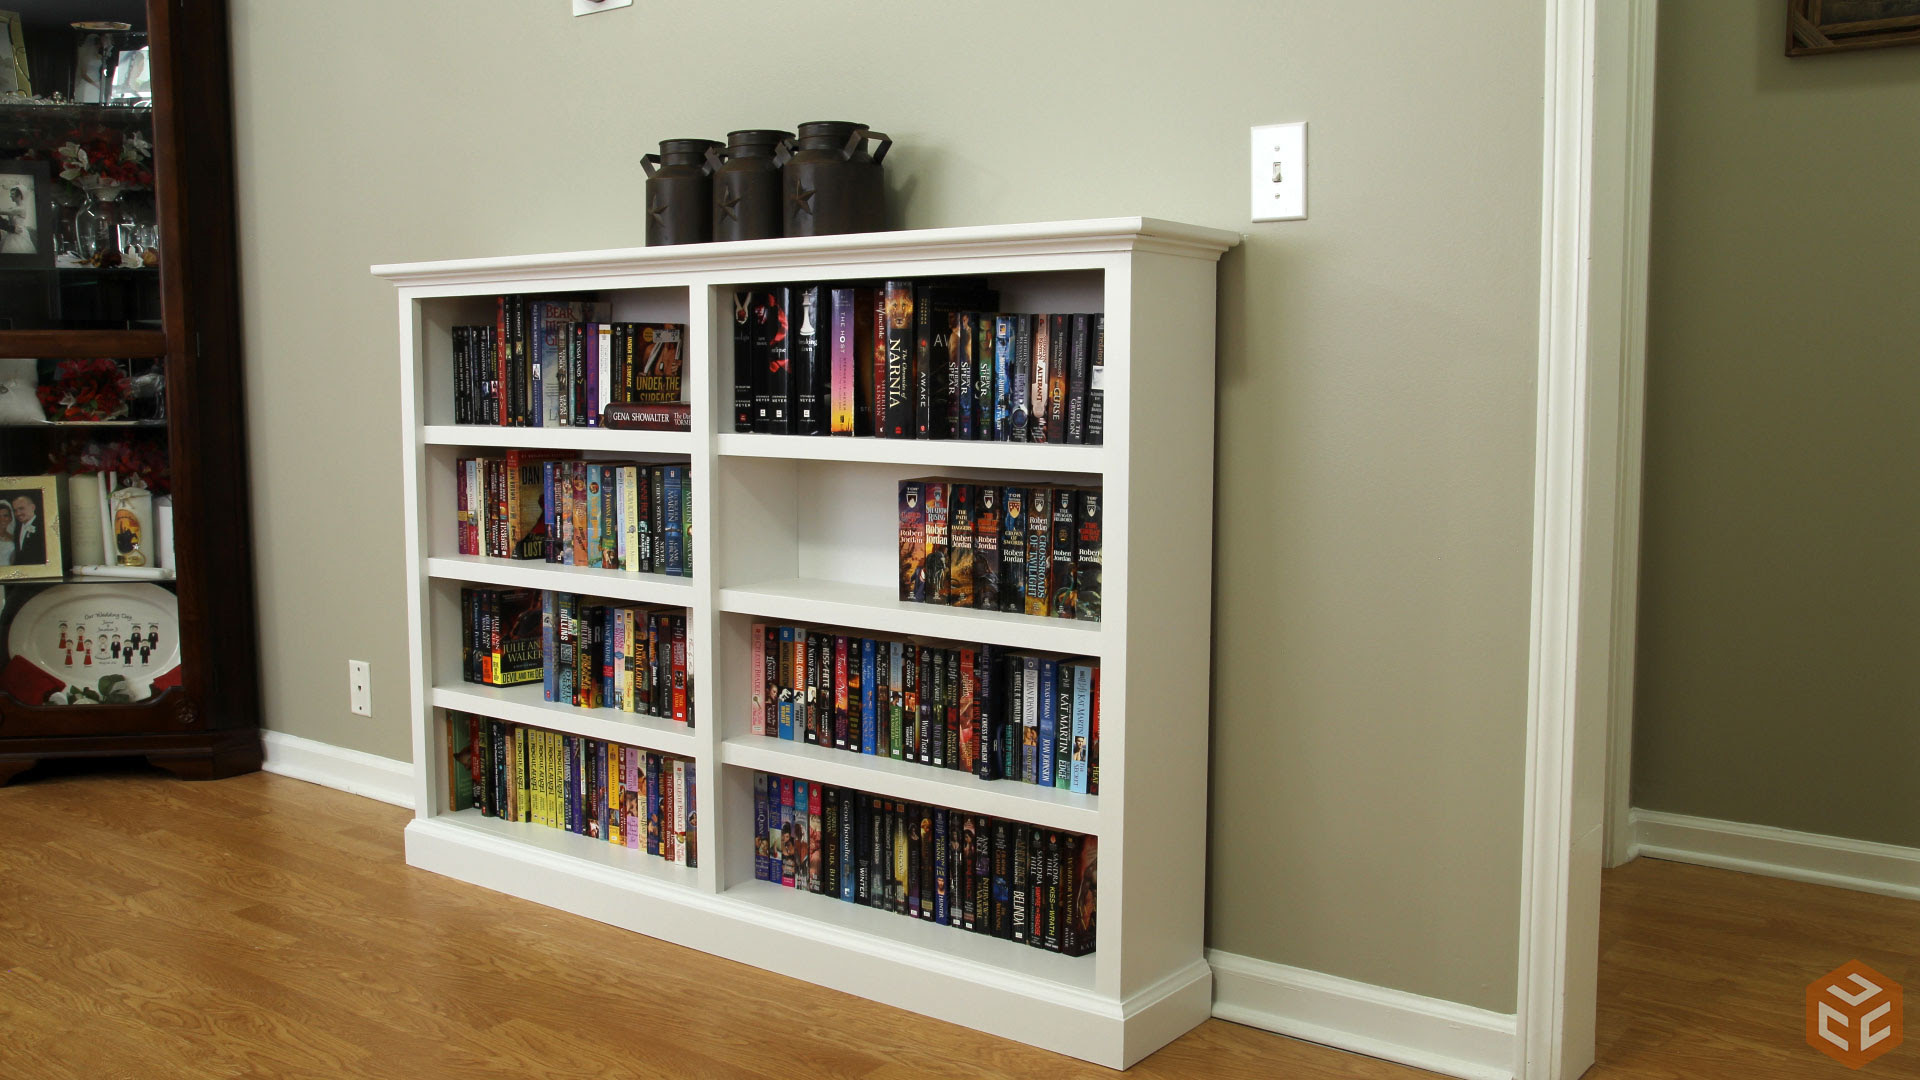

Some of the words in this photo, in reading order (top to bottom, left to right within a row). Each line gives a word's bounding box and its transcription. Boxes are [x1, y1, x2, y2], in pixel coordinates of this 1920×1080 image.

[545, 304, 574, 318] BEAR
[1096, 332, 1104, 366] Predatory
[497, 337, 505, 411] GATEWAY
[636, 376, 663, 391] UNDER
[664, 377, 681, 391] THE
[889, 338, 901, 409] NARNIA
[960, 361, 968, 395] SPEAR
[980, 363, 988, 397] SPEAR
[1036, 365, 1044, 402] ALTERANT
[1052, 387, 1061, 421] CURSE
[612, 410, 631, 422] GENA
[631, 412, 670, 424] SHOWALTER
[1069, 398, 1077, 435] GRYPHON
[1075, 413, 1082, 423] OF
[522, 466, 540, 485] DAN
[667, 489, 675, 522] MARTIN
[927, 513, 946, 522] RISING
[1028, 523, 1048, 531] Jordan
[1029, 516, 1048, 524] Robert
[899, 529, 923, 537] Robert
[925, 524, 948, 535] Robert
[951, 534, 973, 543] Robert
[523, 541, 543, 558] LOST
[899, 536, 924, 544] Jordan
[925, 534, 948, 546] Jordan
[951, 541, 973, 550] Jordan
[977, 536, 998, 544] Robert
[977, 542, 997, 551] Jordan
[1028, 534, 1038, 548] OF
[1002, 555, 1024, 563] Jordan
[1003, 548, 1024, 556] Robert
[1078, 548, 1101, 556] Robert
[1027, 550, 1038, 598] TWILIGHT
[1037, 535, 1047, 598] CROSSROADS
[95, 611, 120, 620] Wedding
[121, 613, 133, 622] Day
[560, 608, 569, 641] ROLLINS
[580, 620, 588, 650] ROLLINS
[503, 642, 526, 655] JULIE
[508, 650, 544, 663] WALKER
[604, 638, 612, 663] FEATHER
[635, 643, 644, 665] DARK
[796, 643, 804, 665] MICHAEL
[807, 647, 815, 667] NALINI
[822, 647, 830, 665] KISS
[502, 672, 518, 685] DEVIL
[635, 666, 644, 689] LORD
[795, 665, 804, 691] CRICHTON
[822, 668, 830, 689] FATE
[1026, 680, 1036, 695] JOAN
[1026, 695, 1035, 725] JOHNSTON
[1060, 693, 1069, 713] KAT
[1077, 694, 1085, 707] KAT
[921, 720, 929, 738] WHITE
[1076, 708, 1084, 735] MARTIN
[1059, 714, 1069, 754] MARTIN
[1042, 738, 1051, 754] JOAN
[1041, 754, 1051, 782] JOHNSTON
[1058, 759, 1067, 780] EDGE
[1092, 766, 1100, 785] HEAT
[843, 800, 851, 822] Gena
[843, 823, 851, 862] Showalter
[1035, 849, 1043, 885] SANDRA
[982, 877, 990, 913] INTERVIEW
[1013, 890, 1025, 926] BELINDA
[1048, 909, 1056, 936] WRATH
